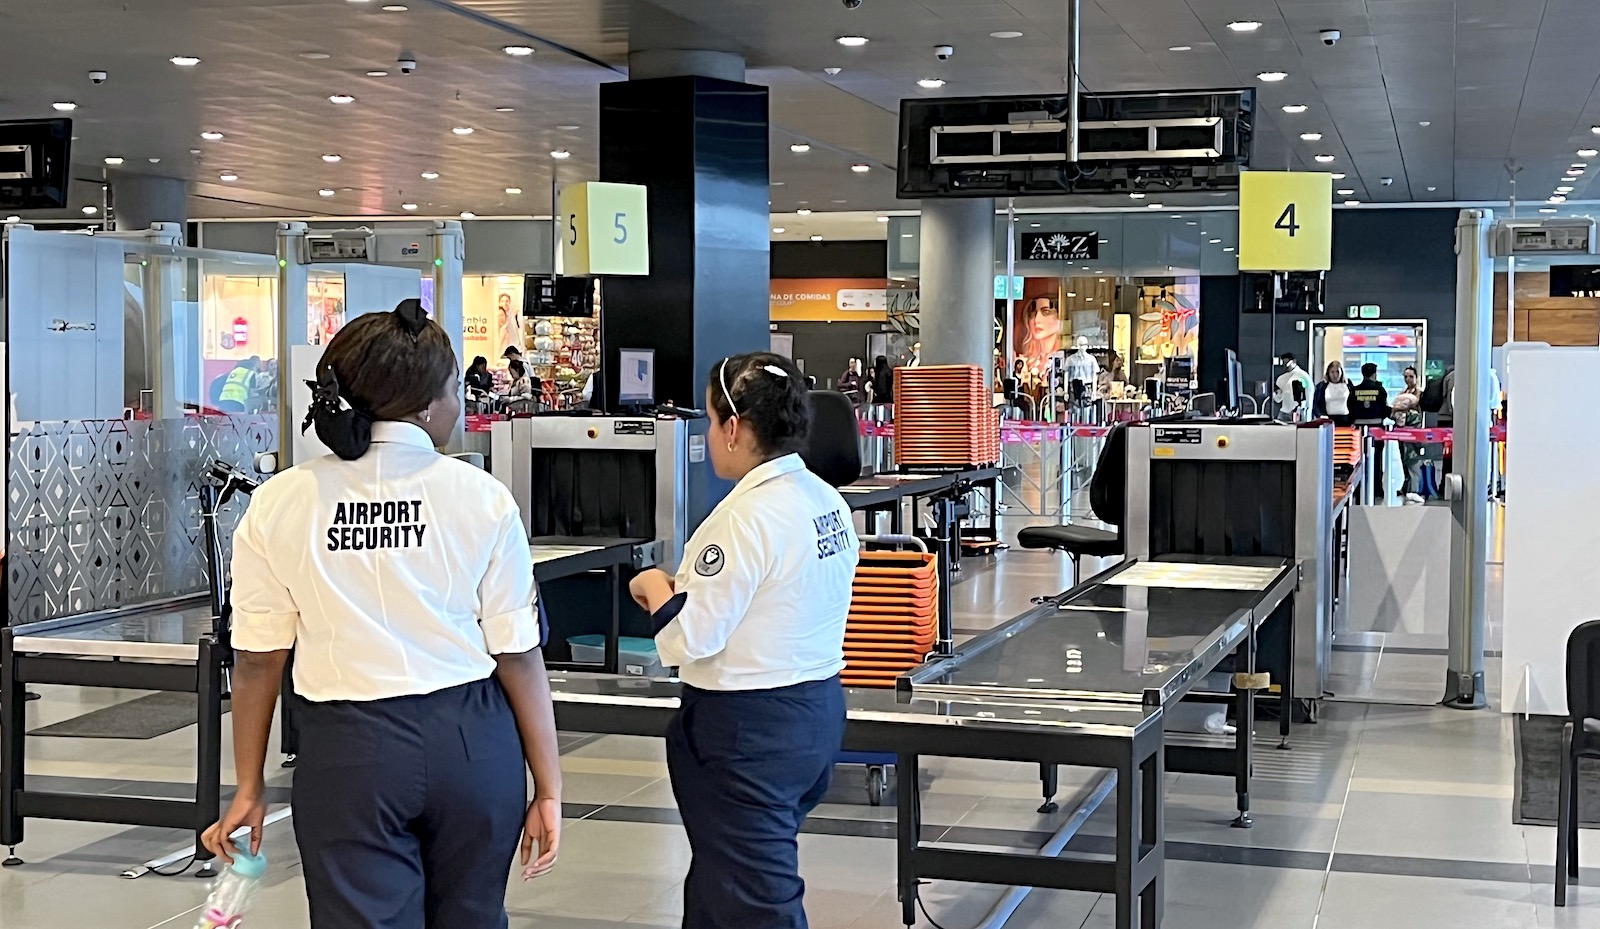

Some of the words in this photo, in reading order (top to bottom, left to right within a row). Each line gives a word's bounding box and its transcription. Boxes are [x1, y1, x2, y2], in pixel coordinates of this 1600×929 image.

[570, 213, 577, 246] 5
[613, 212, 627, 245] 5
[1274, 203, 1300, 237] 4
[783, 293, 793, 301] DE
[795, 293, 832, 301] COMIDAS
[333, 500, 422, 525] AIRPORT
[812, 509, 845, 538] AIRPORT
[327, 524, 427, 551] SECURITY
[817, 528, 851, 559] SECURITY
